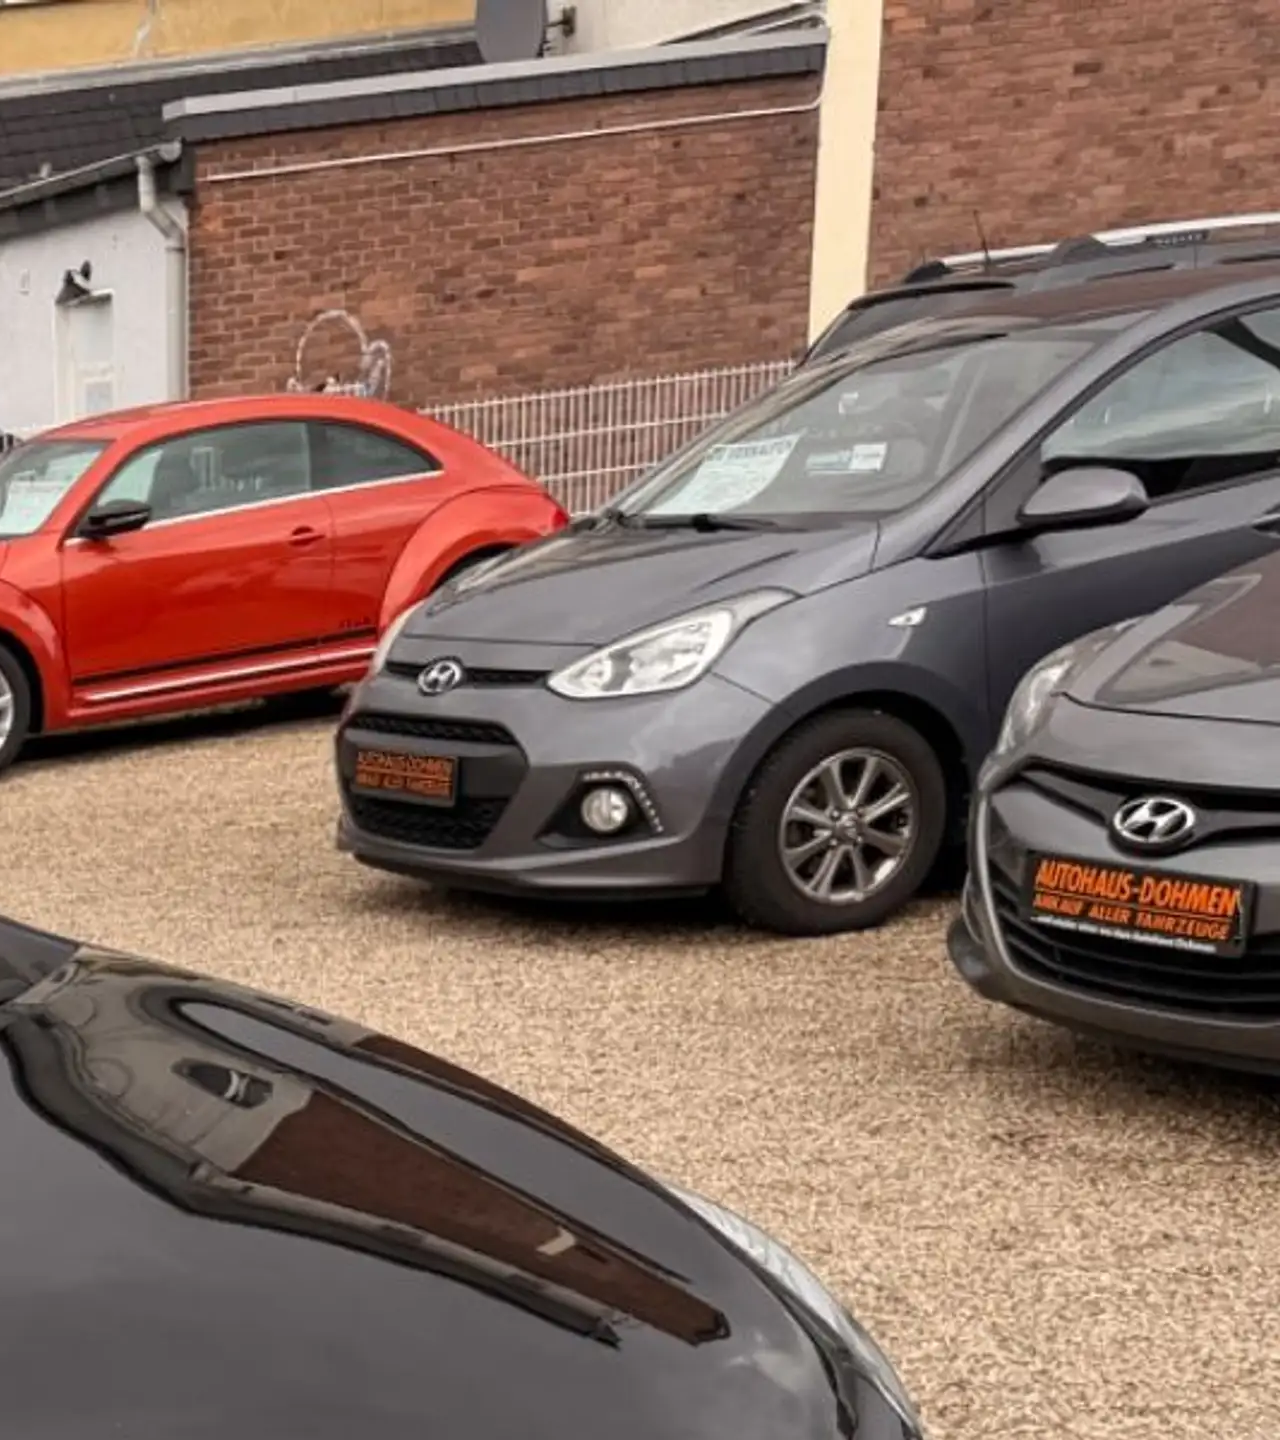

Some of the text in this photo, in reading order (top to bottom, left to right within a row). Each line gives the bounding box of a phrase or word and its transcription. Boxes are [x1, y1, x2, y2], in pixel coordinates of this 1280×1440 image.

[1036, 859, 1243, 917] AUTOHAUS-DOHMEN
[1088, 902, 1131, 924] ALLER
[1134, 911, 1231, 941] FAHRZEUGE
